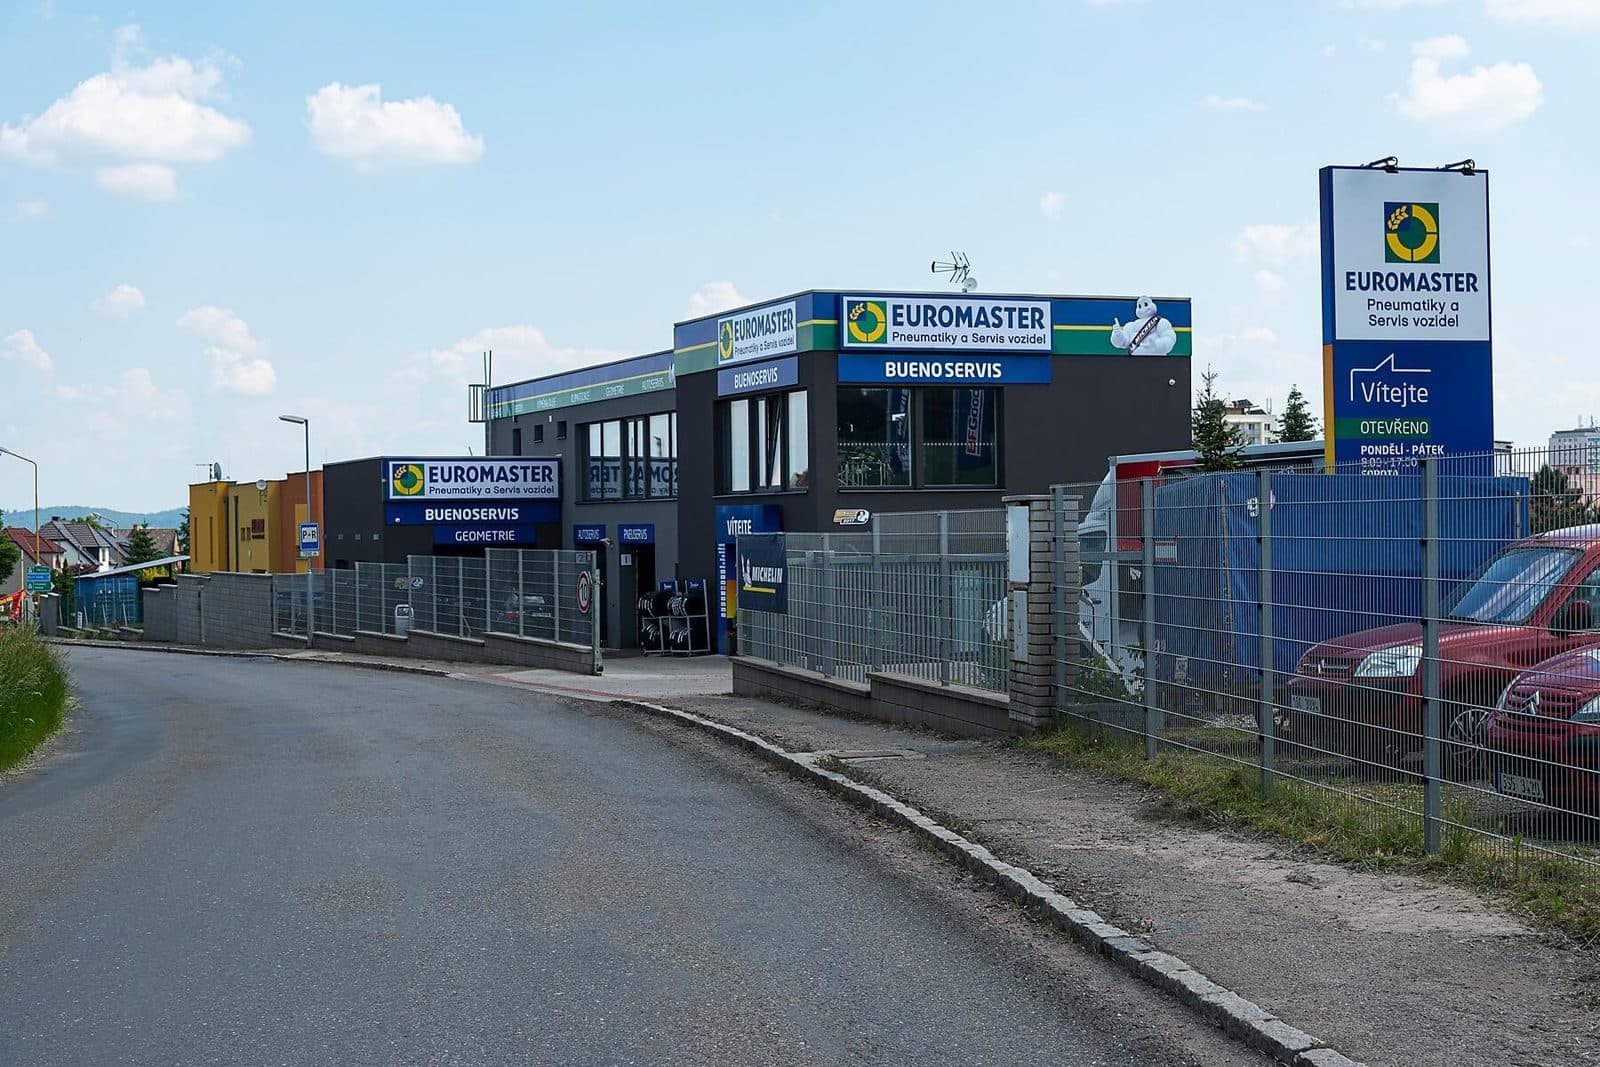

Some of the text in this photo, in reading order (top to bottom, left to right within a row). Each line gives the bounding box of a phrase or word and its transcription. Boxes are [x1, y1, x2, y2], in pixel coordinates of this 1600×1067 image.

[1345, 271, 1478, 292] EUROMASTER
[1367, 299, 1459, 314] Pneumatiky a
[892, 304, 1045, 330] EUROMASTER
[1368, 314, 1459, 327] Servis vozidel
[734, 308, 794, 342] EUROMASTER
[764, 339, 778, 351] Servis
[892, 331, 1046, 345] Pneumatiky a Servis vozidel
[734, 367, 778, 389] BUENOSERVIS
[1361, 381, 1428, 407] Vítejte
[1360, 418, 1429, 434] OTEVŘENO
[1361, 443, 1404, 455] PONDĚLÍ
[1411, 443, 1444, 455] PÁTEK
[429, 465, 554, 483] EUROMASTER
[429, 486, 482, 496] Pneumatiky
[493, 486, 521, 495] Servis
[523, 486, 555, 495] vozidel
[425, 508, 519, 521] BUENOSERVIS
[302, 530, 317, 539] P+R
[455, 530, 515, 542] GEOMETRIE
[751, 566, 783, 584] MICHELIN
